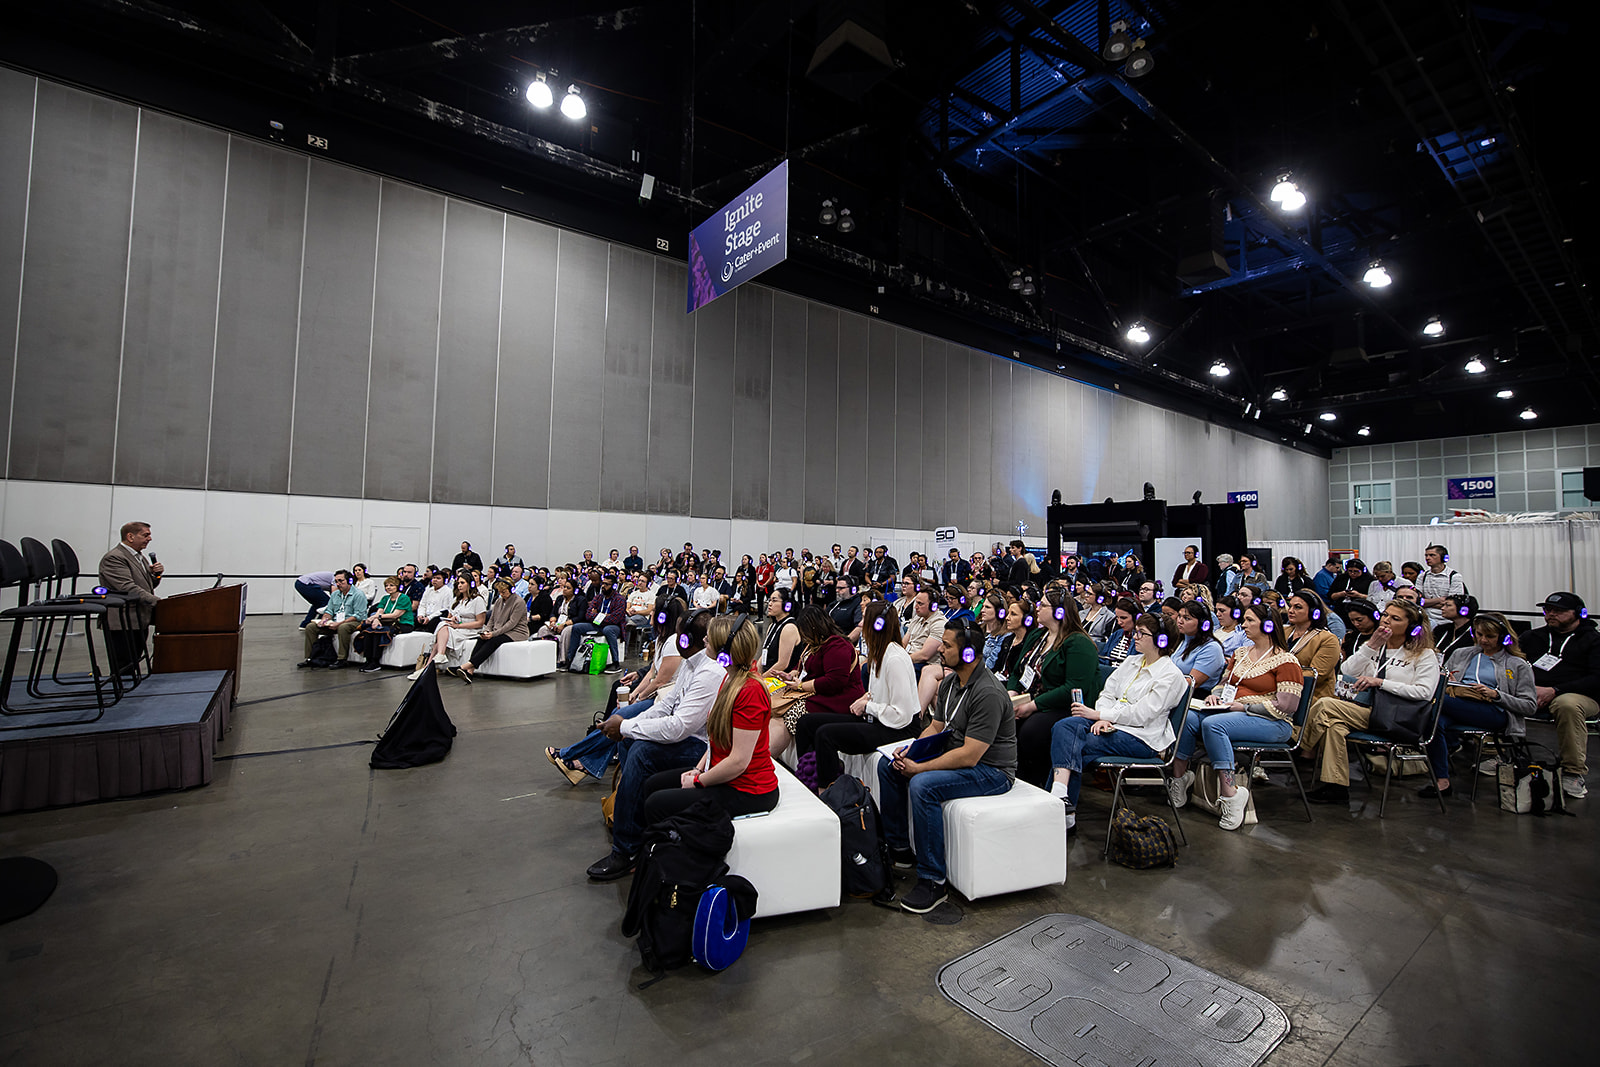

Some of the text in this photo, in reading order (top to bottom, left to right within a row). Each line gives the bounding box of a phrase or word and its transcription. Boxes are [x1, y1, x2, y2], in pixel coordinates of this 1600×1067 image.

[308, 135, 328, 149] 23
[724, 192, 763, 232] Ignite
[725, 220, 761, 255] Stage
[657, 239, 668, 250] 22
[734, 232, 780, 268] Cater+Event
[1460, 480, 1494, 490] 1500
[1235, 493, 1257, 502] 1600
[1505, 669, 1514, 680] R
